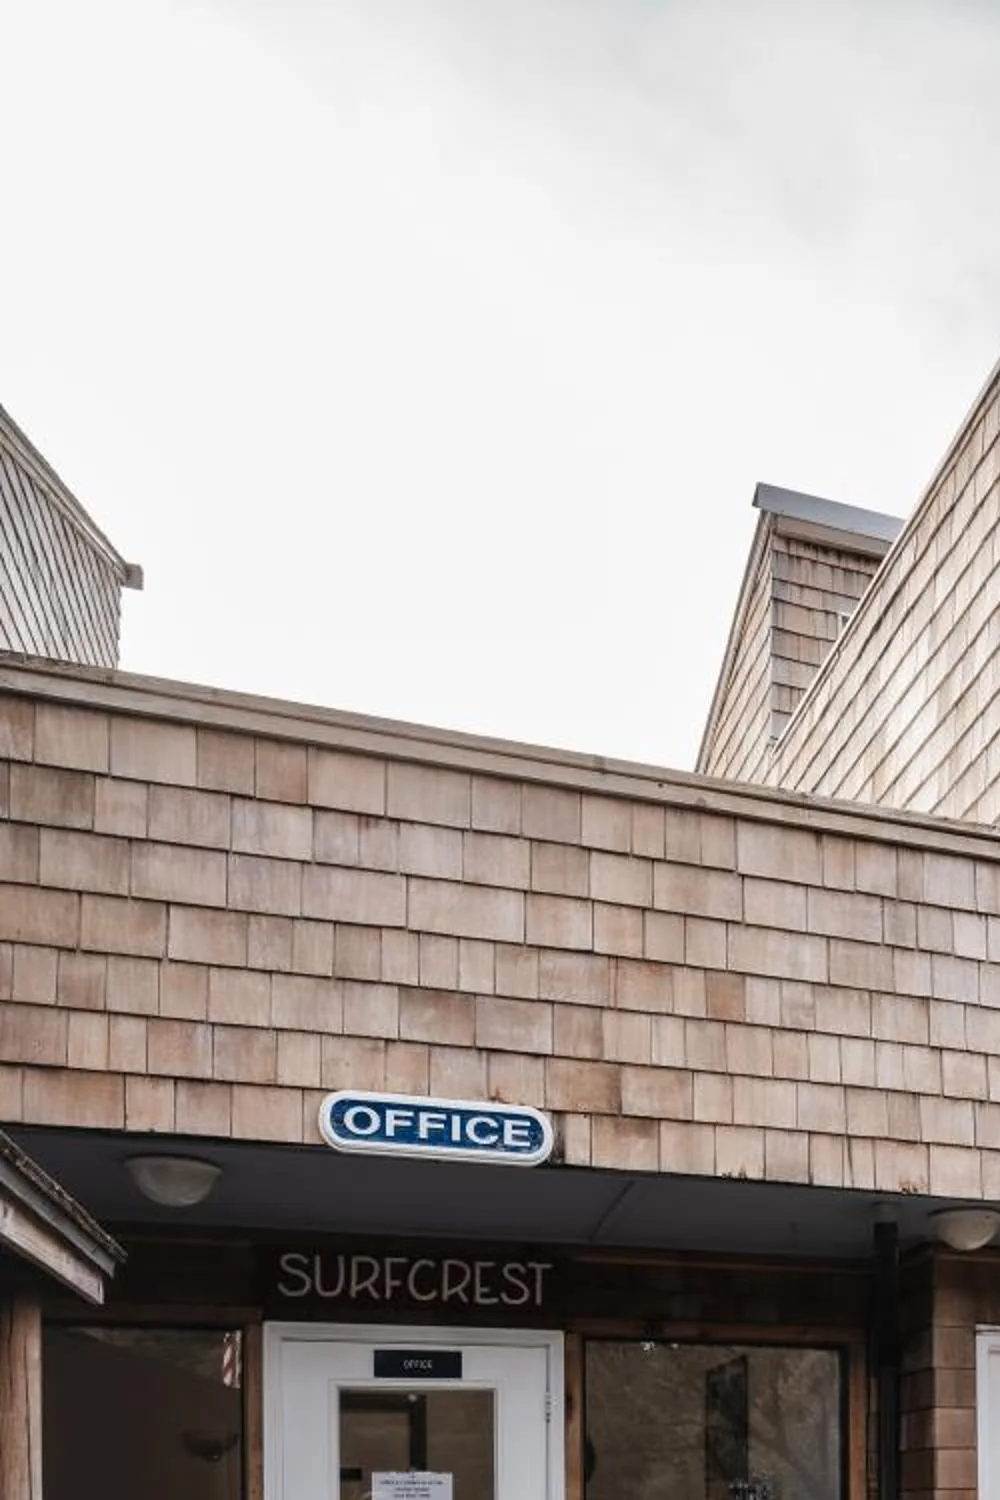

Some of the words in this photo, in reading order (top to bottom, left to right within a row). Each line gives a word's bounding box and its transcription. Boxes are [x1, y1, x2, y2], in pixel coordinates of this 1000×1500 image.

[342, 1105, 532, 1148] OFFICE
[277, 1252, 553, 1307] SURFCREST
[402, 1359, 433, 1370] OFFICE
